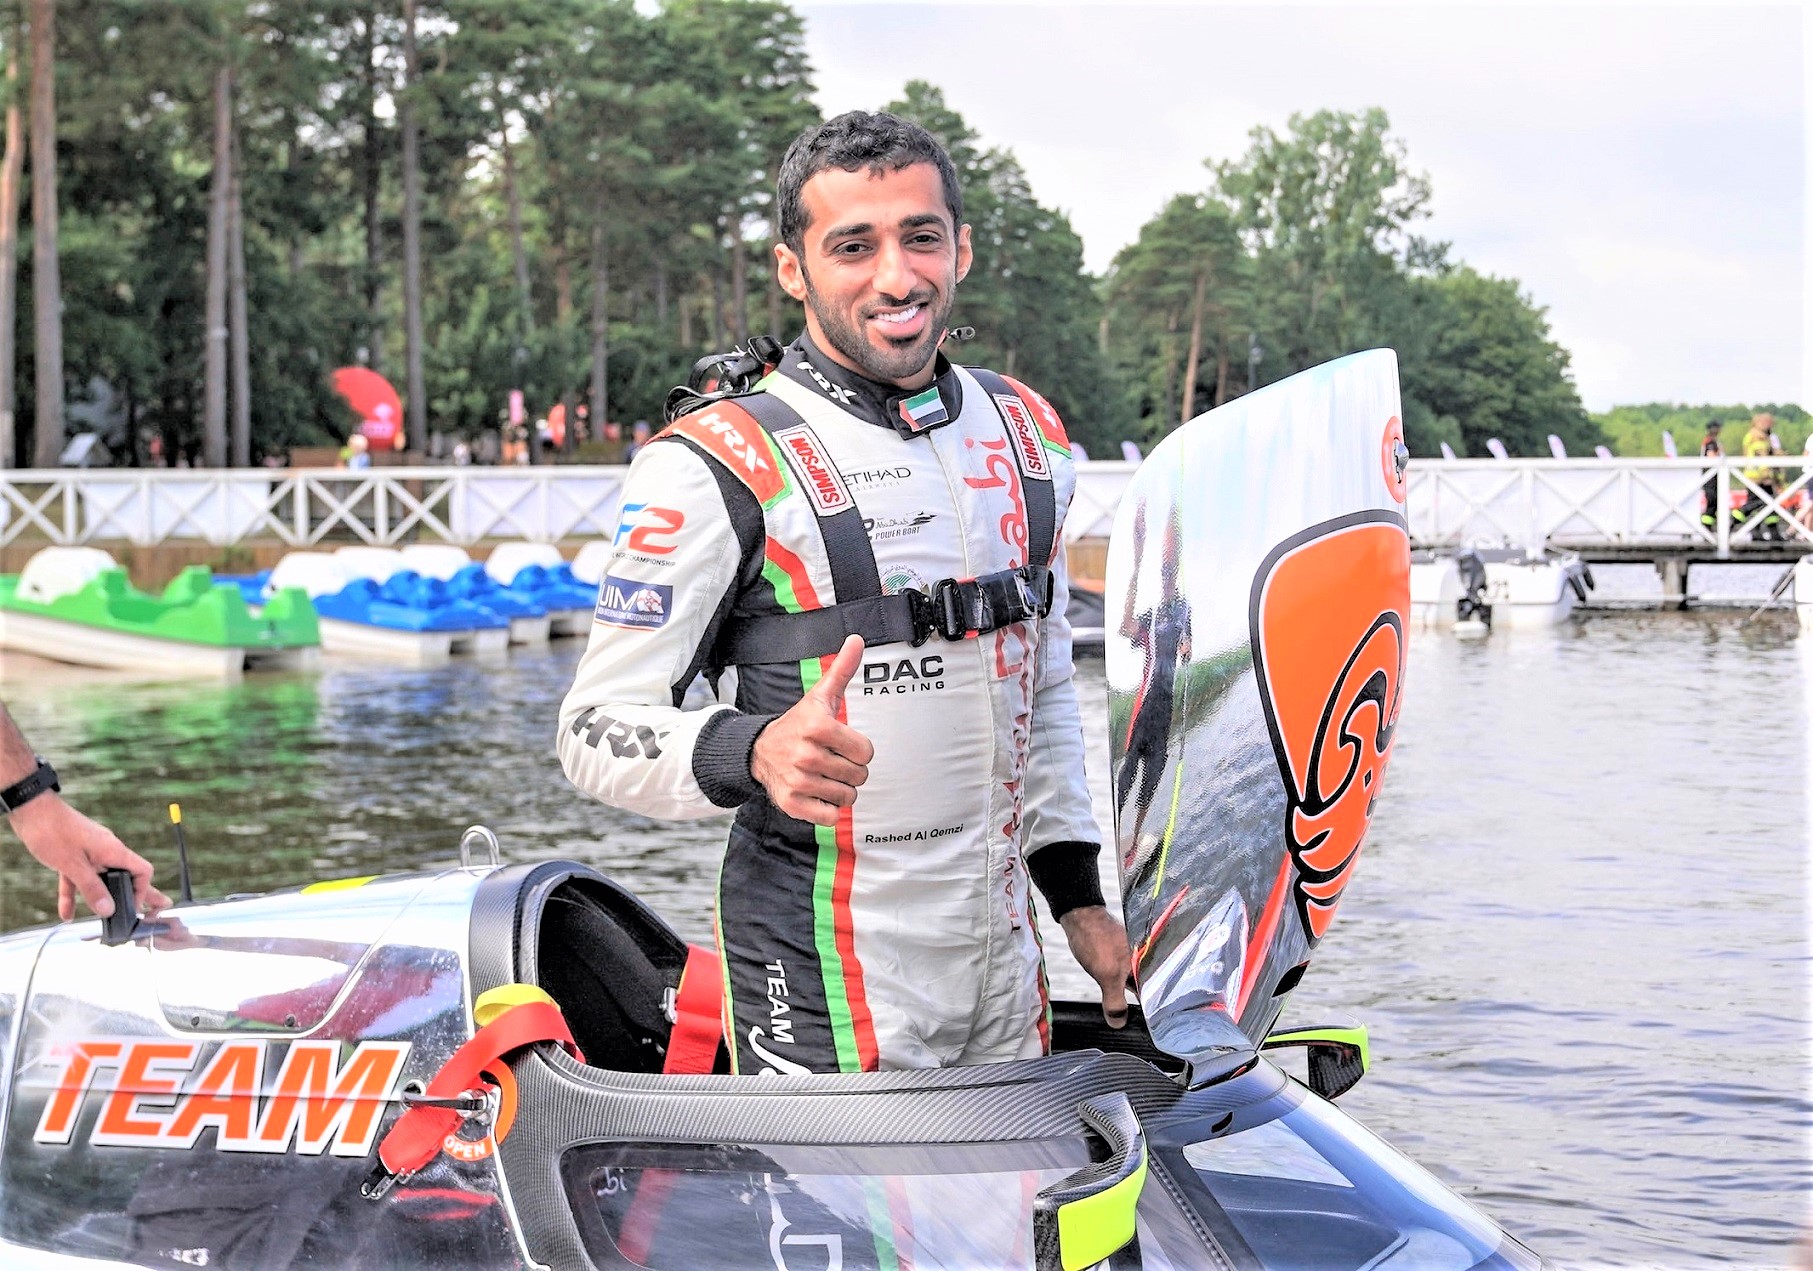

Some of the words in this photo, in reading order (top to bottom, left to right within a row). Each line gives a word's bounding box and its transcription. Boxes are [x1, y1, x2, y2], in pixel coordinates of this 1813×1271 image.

[797, 361, 858, 405] HRX
[697, 412, 771, 474] HRX
[1005, 404, 1042, 471] SIMPSON
[789, 437, 841, 506] SIMPSON
[842, 467, 912, 486] ETIHAD
[613, 502, 685, 555] F2
[875, 529, 901, 540] POWER
[902, 526, 921, 537] BOAT
[629, 554, 677, 567] CHAMPIONSHIP
[600, 584, 639, 611] UIM
[863, 655, 945, 684] DAC
[863, 680, 945, 696] RACING
[865, 832, 912, 844] Rashed
[914, 831, 927, 841] Al
[929, 823, 964, 839] Qemzi
[1003, 855, 1022, 934] TEAM
[765, 958, 795, 1045] TEAM
[34, 1040, 411, 1157] TEAM
[443, 1134, 486, 1159] OPEN
